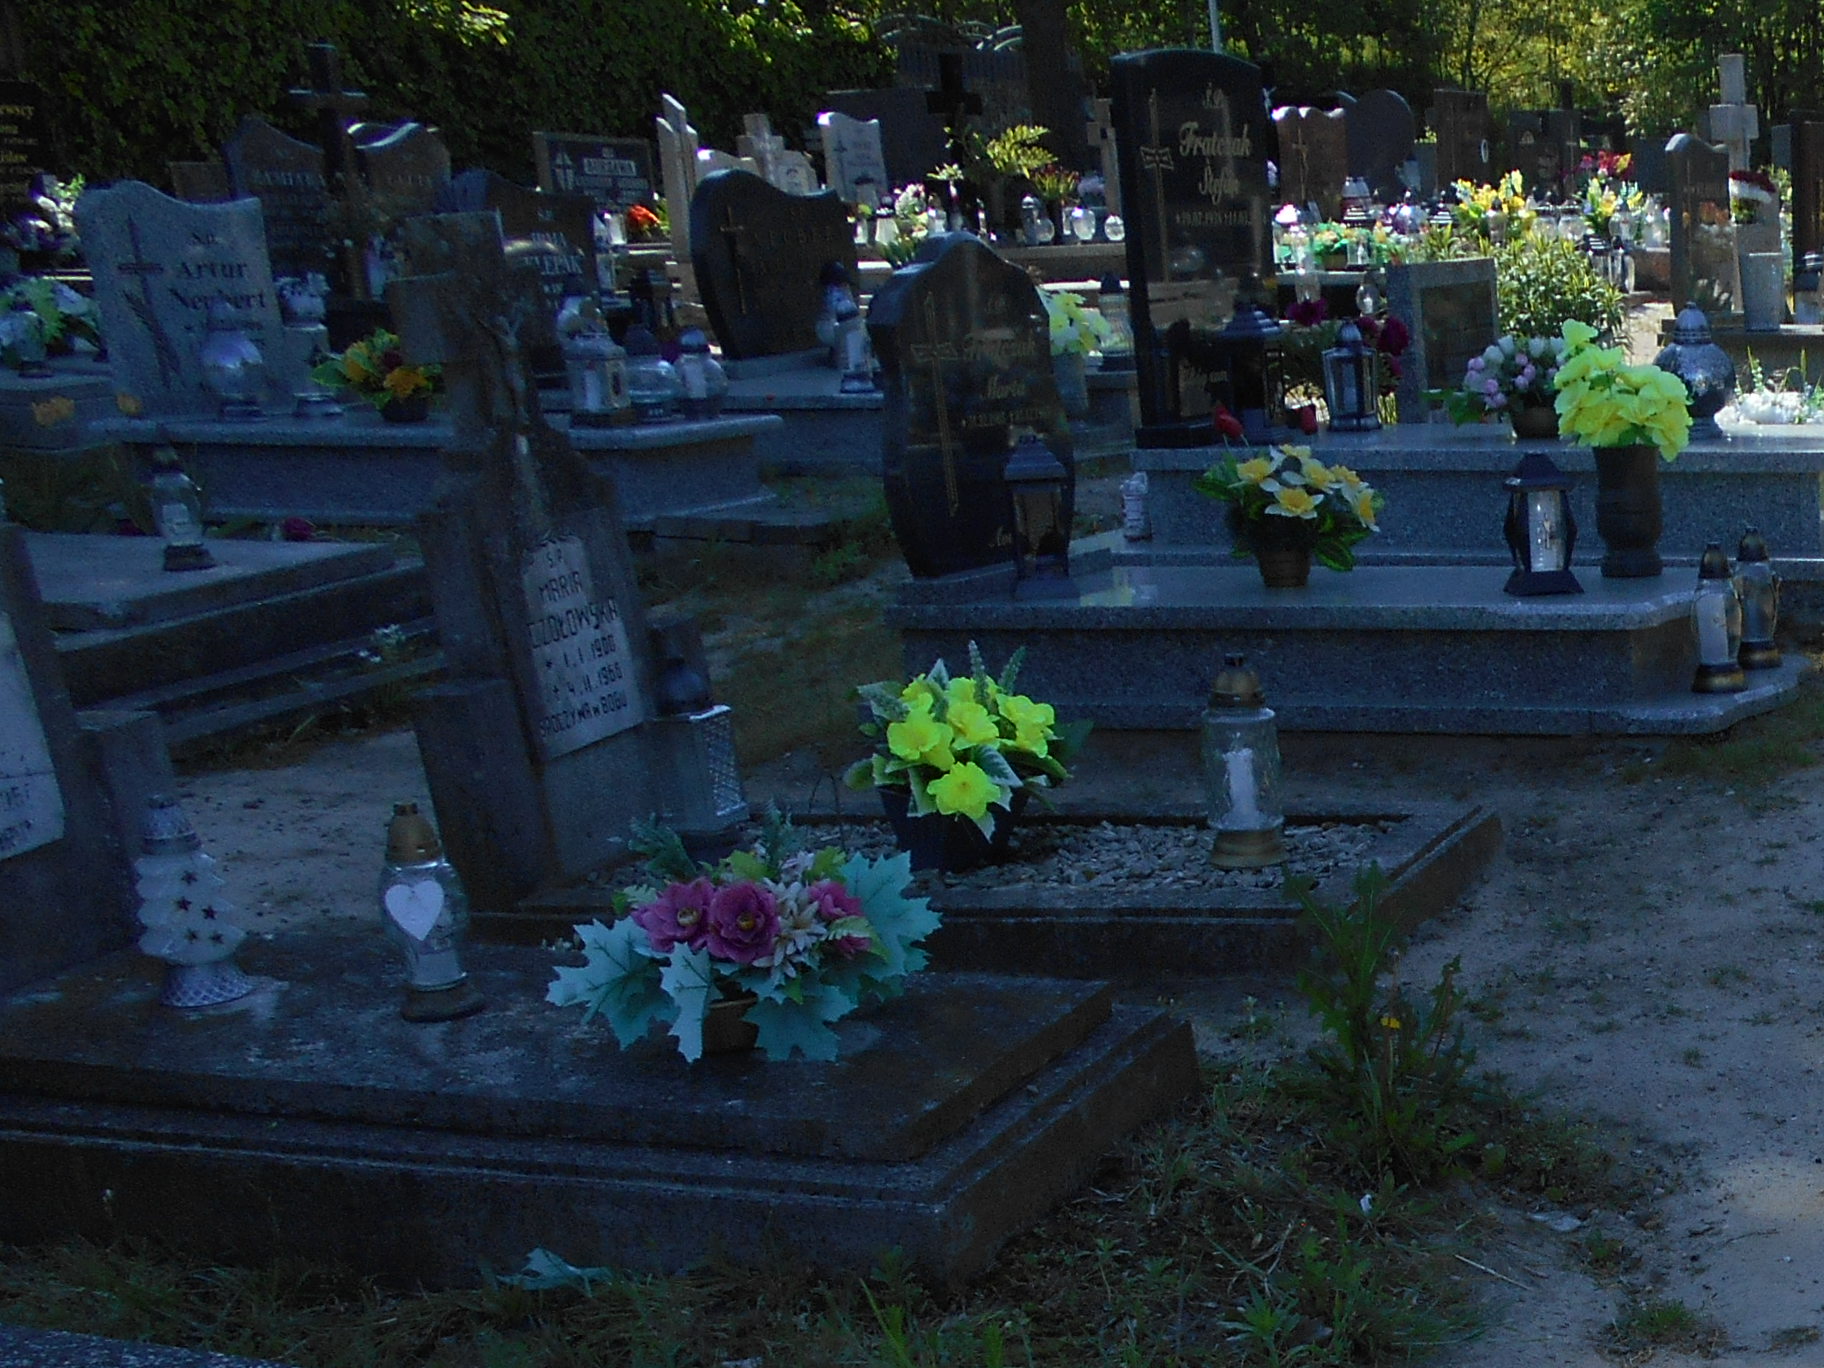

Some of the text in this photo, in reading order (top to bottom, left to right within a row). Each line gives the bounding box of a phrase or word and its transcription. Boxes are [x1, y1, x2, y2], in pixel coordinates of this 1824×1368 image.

[177, 262, 248, 278] Artur
[539, 570, 584, 603] MARIA
[526, 595, 620, 649] CZOŁOWSKA
